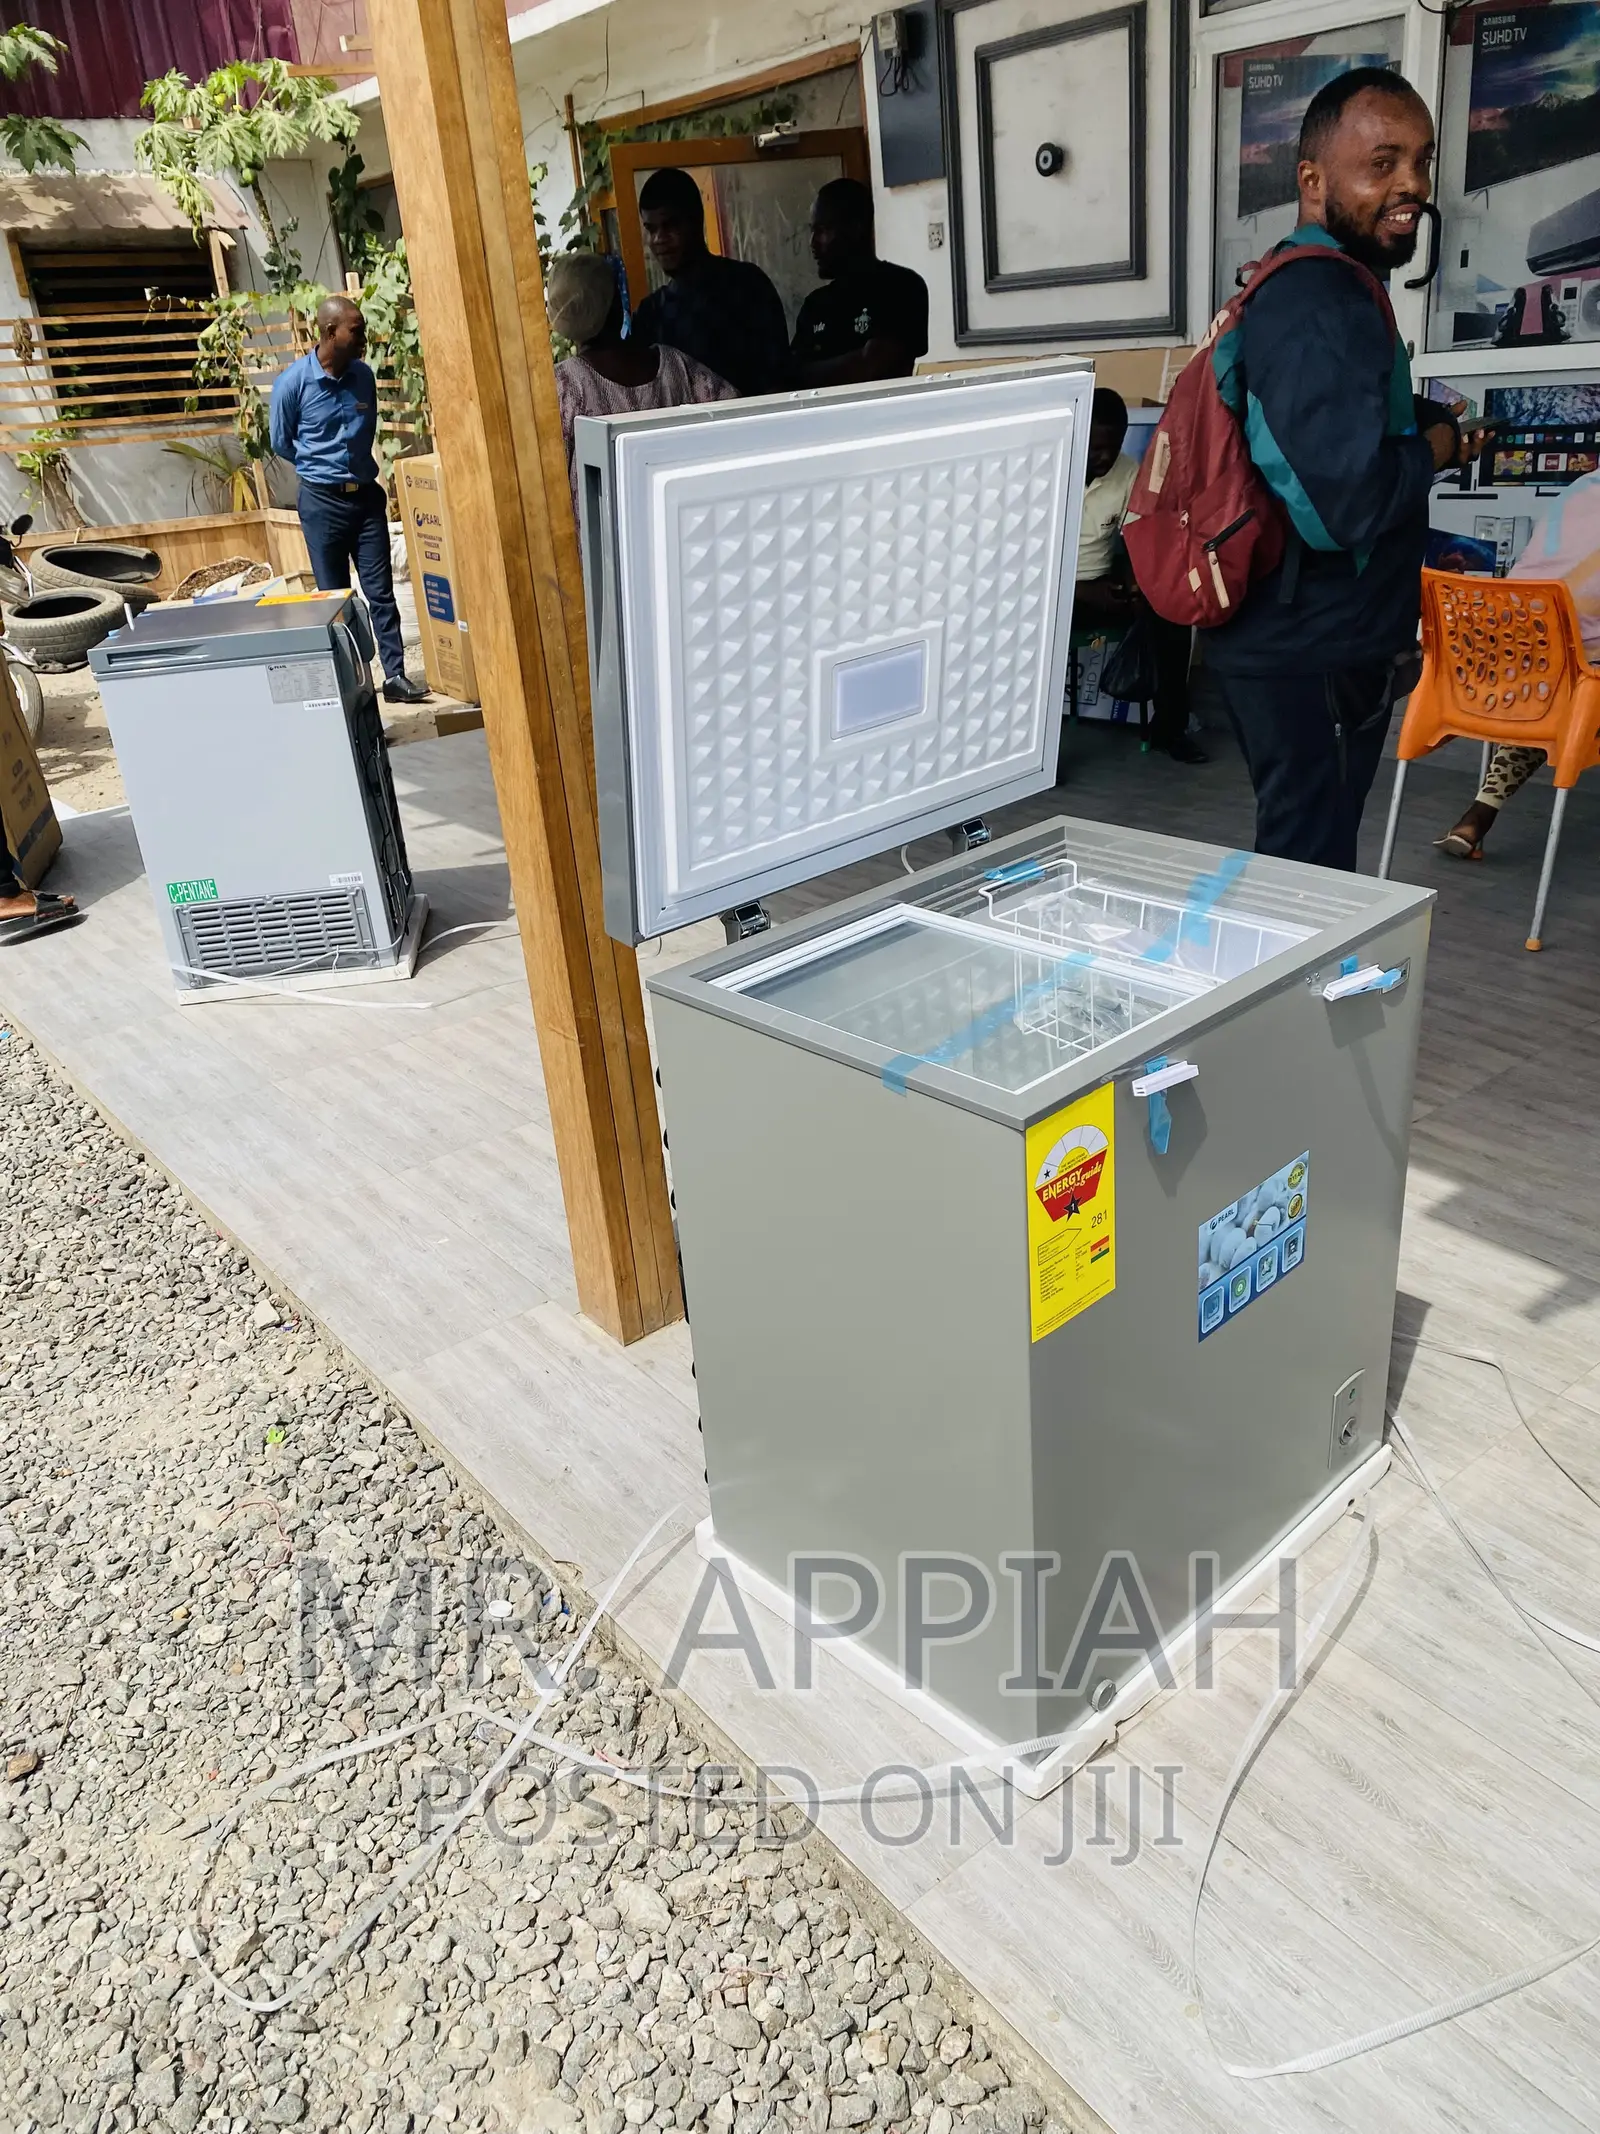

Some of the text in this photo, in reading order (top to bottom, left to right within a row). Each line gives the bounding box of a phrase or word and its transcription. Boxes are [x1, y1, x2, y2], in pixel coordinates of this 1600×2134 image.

[1482, 15, 1516, 25] SAMSUNG
[1482, 27, 1527, 45] SUHD TV
[1249, 75, 1284, 89] SUHD TV
[421, 512, 441, 526] PEARL
[168, 882, 218, 902] C-PENTANE
[1043, 1161, 1102, 1202] ENERGY guide
[1091, 1209, 1108, 1228] 281
[1217, 1209, 1235, 1223] PEARL
